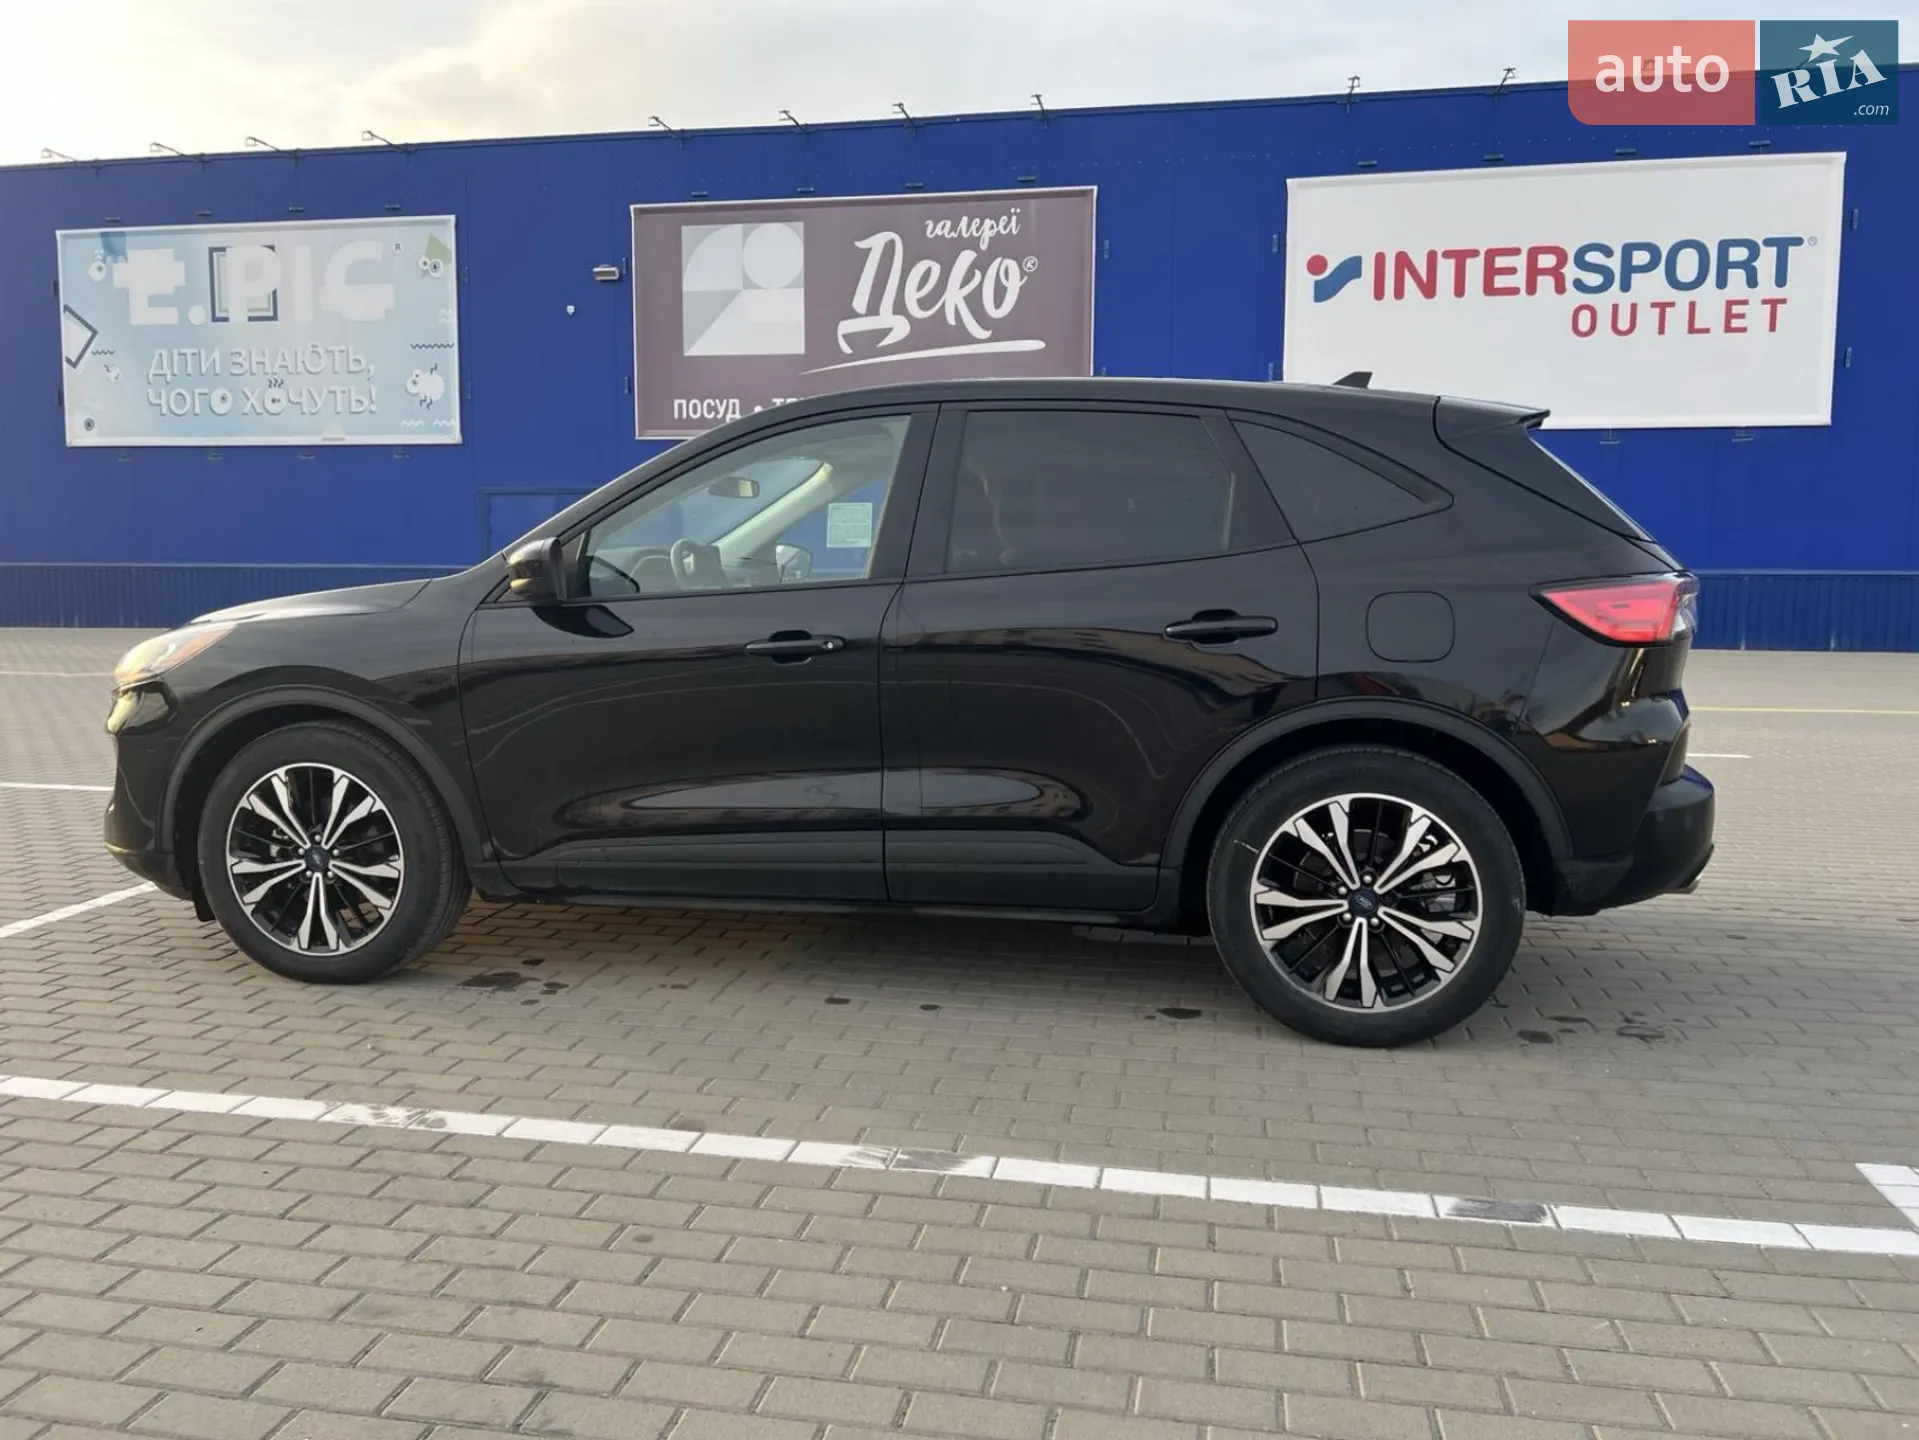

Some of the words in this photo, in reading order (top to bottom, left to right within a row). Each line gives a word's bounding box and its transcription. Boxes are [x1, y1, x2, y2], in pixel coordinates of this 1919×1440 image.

[924, 207, 1022, 251] галереї
[1372, 236, 1805, 301] INTERSPORT
[836, 230, 1028, 355] Деко
[1571, 297, 1788, 338] OUTLET
[147, 348, 222, 385] ДІТИ
[147, 387, 234, 418] ЧОГО
[241, 383, 377, 417] ХОЧУТЬ!
[673, 398, 743, 424] ПОСУД
